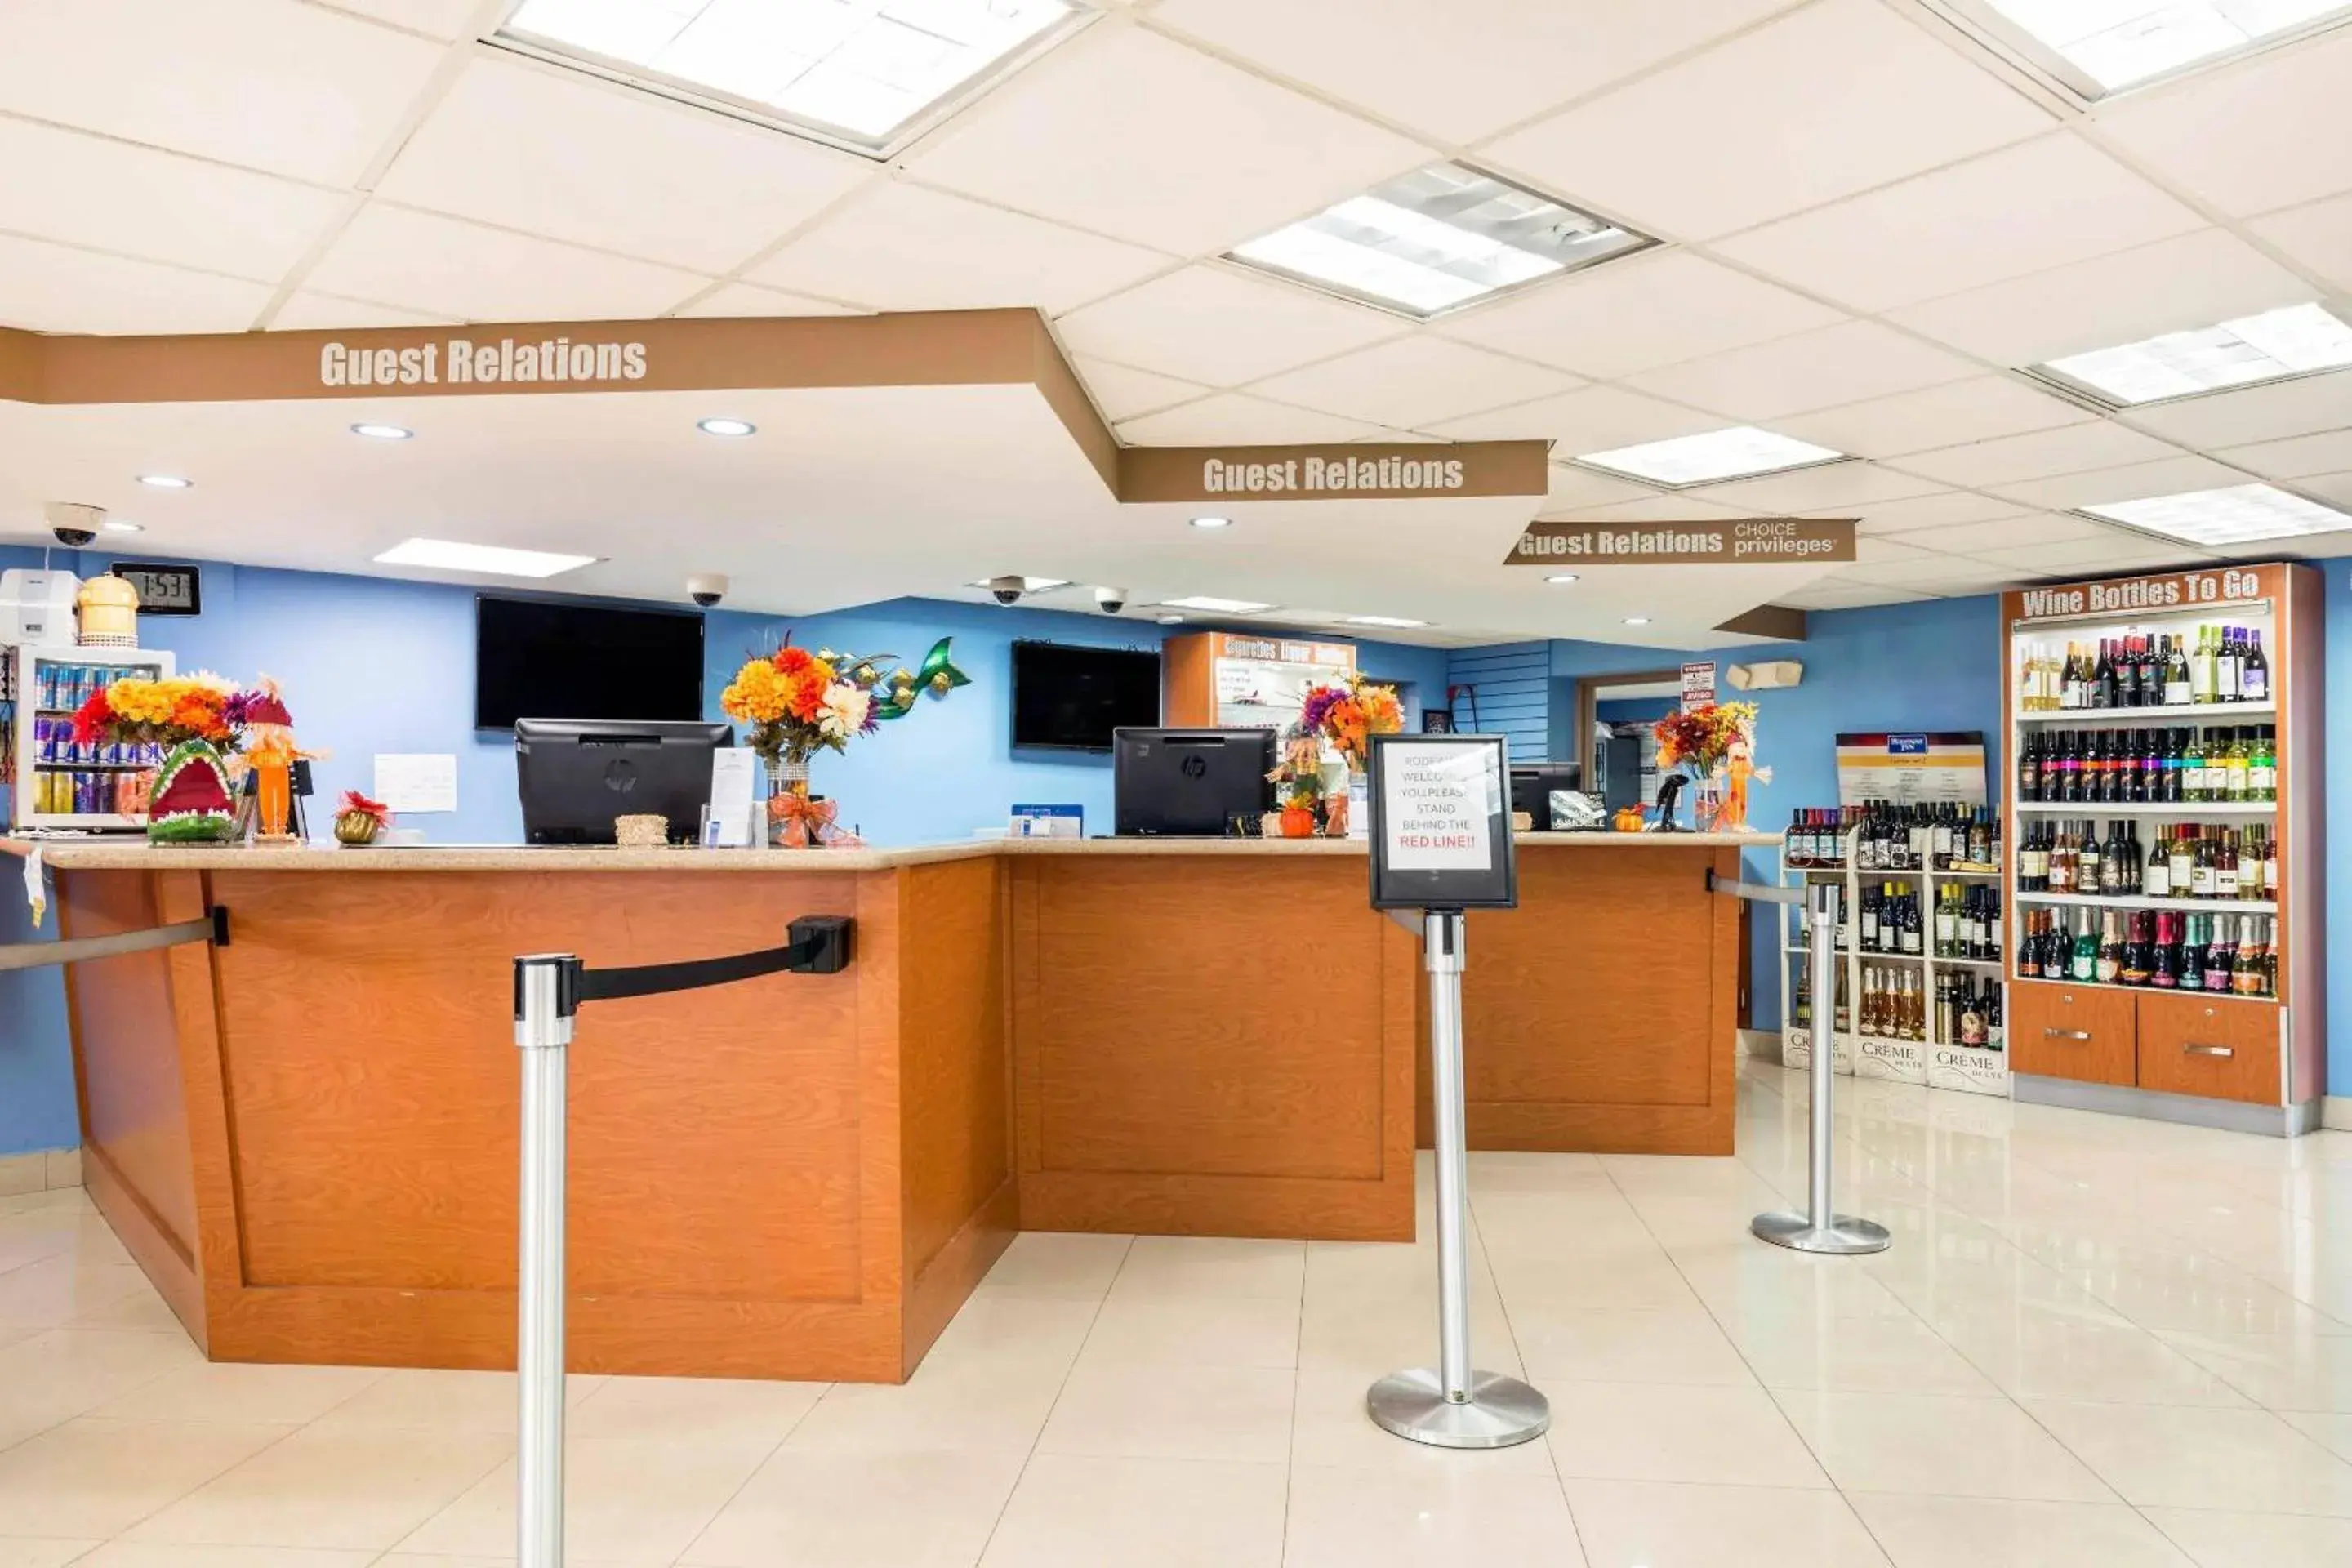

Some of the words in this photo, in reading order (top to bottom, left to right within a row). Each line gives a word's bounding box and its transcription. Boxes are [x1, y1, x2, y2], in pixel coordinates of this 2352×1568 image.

[320, 342, 439, 386] Guest
[447, 337, 647, 383] Relations
[1203, 458, 1298, 492] Guest
[1304, 456, 1464, 490] Relations
[1735, 523, 1796, 537] CHOICE
[1517, 532, 1592, 556] Guest
[1598, 529, 1723, 555] Relations
[1735, 536, 1833, 557] privileges
[2022, 589, 2083, 617] Wine
[2089, 579, 2180, 611] Bottles
[2185, 574, 2217, 601] To
[2223, 570, 2260, 598] Go
[1417, 804, 1456, 814] STAND
[1403, 820, 1446, 830] BEHIND
[1448, 820, 1471, 830] THE
[1400, 835, 1429, 848] RED
